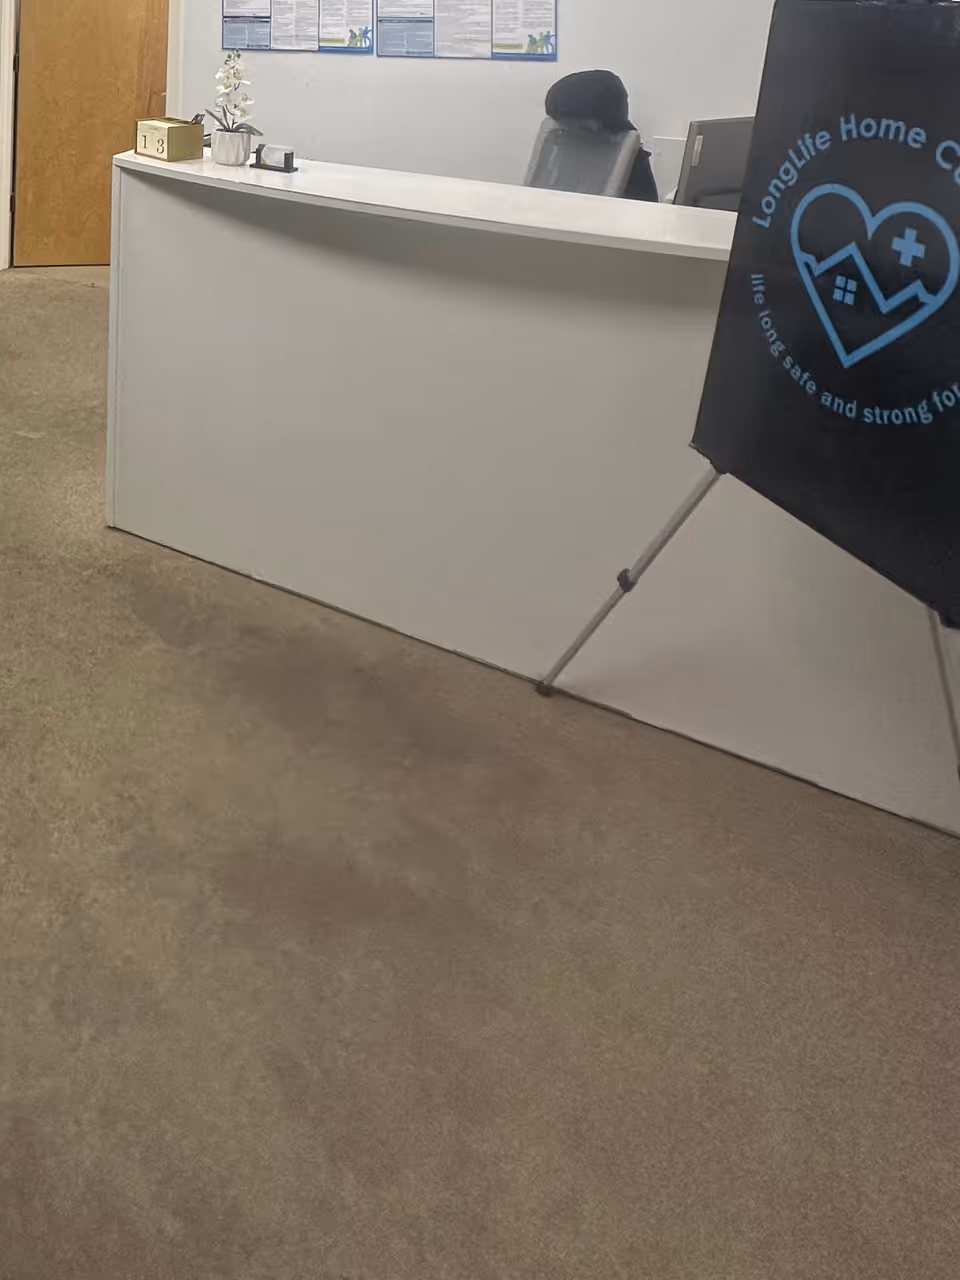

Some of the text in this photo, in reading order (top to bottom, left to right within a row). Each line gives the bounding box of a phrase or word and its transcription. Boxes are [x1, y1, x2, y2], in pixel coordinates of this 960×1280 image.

[157, 138, 164, 154] 3
[752, 128, 832, 229] LongLife
[840, 114, 928, 149] Home
[751, 273, 765, 304] life
[759, 310, 786, 357] long
[783, 356, 816, 393] safe
[820, 389, 858, 419] and
[863, 399, 933, 425] strong
